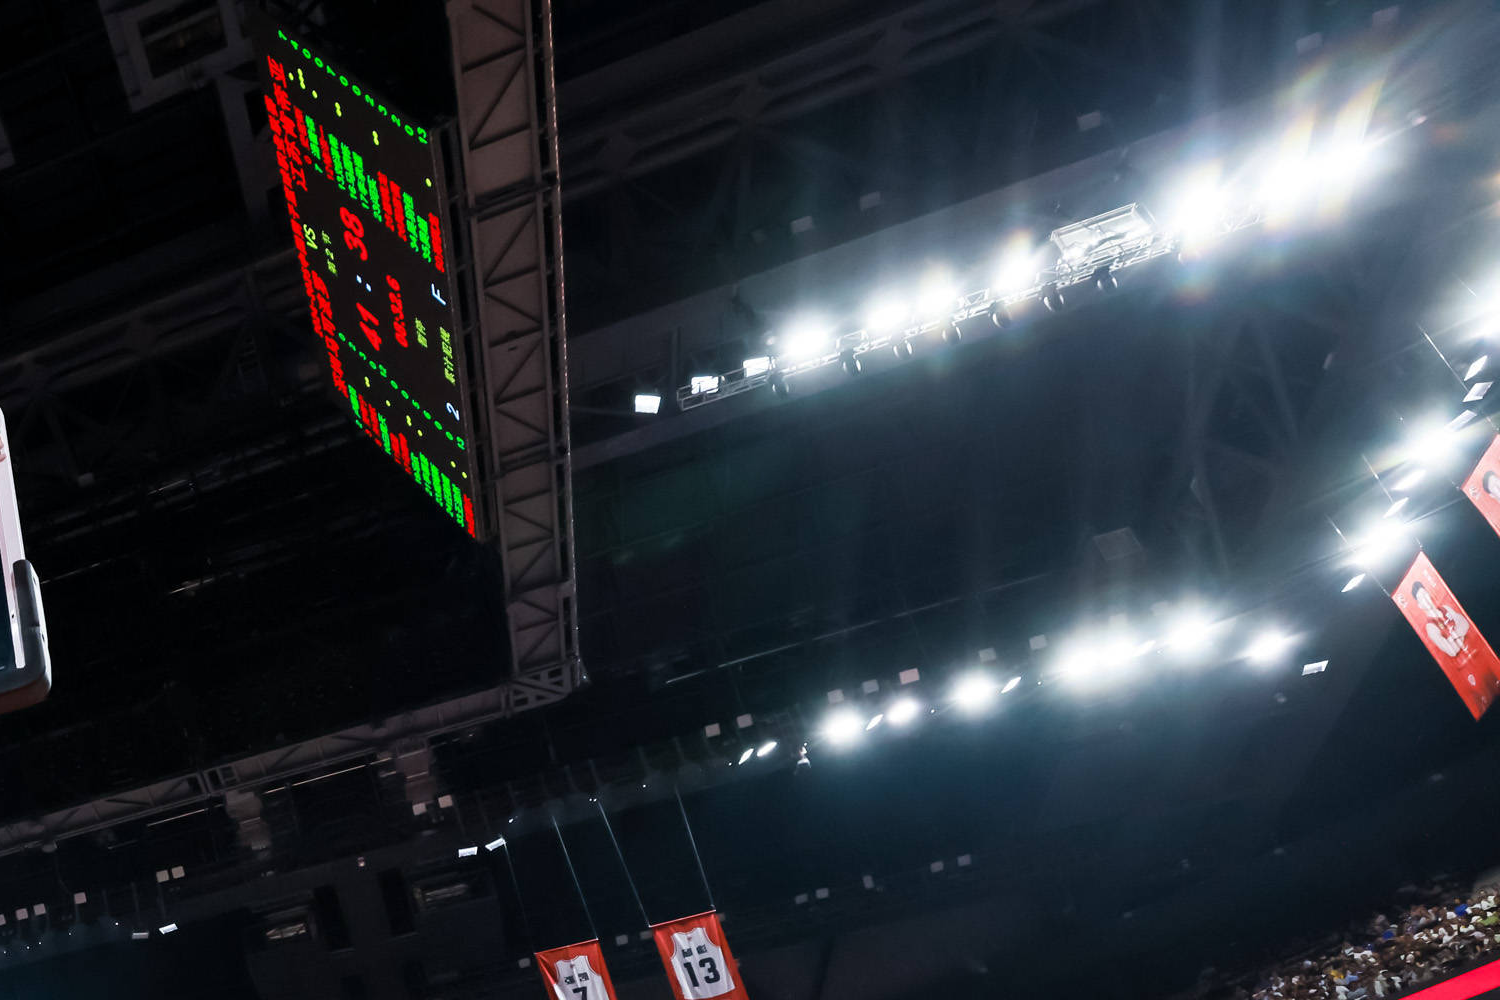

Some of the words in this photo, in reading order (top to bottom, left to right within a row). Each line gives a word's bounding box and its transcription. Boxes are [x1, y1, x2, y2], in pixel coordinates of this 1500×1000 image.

[303, 223, 318, 250] VS
[339, 206, 369, 261] 38
[430, 283, 448, 306] F
[356, 301, 382, 351] 41
[445, 401, 461, 421] 2
[683, 957, 721, 988] 13
